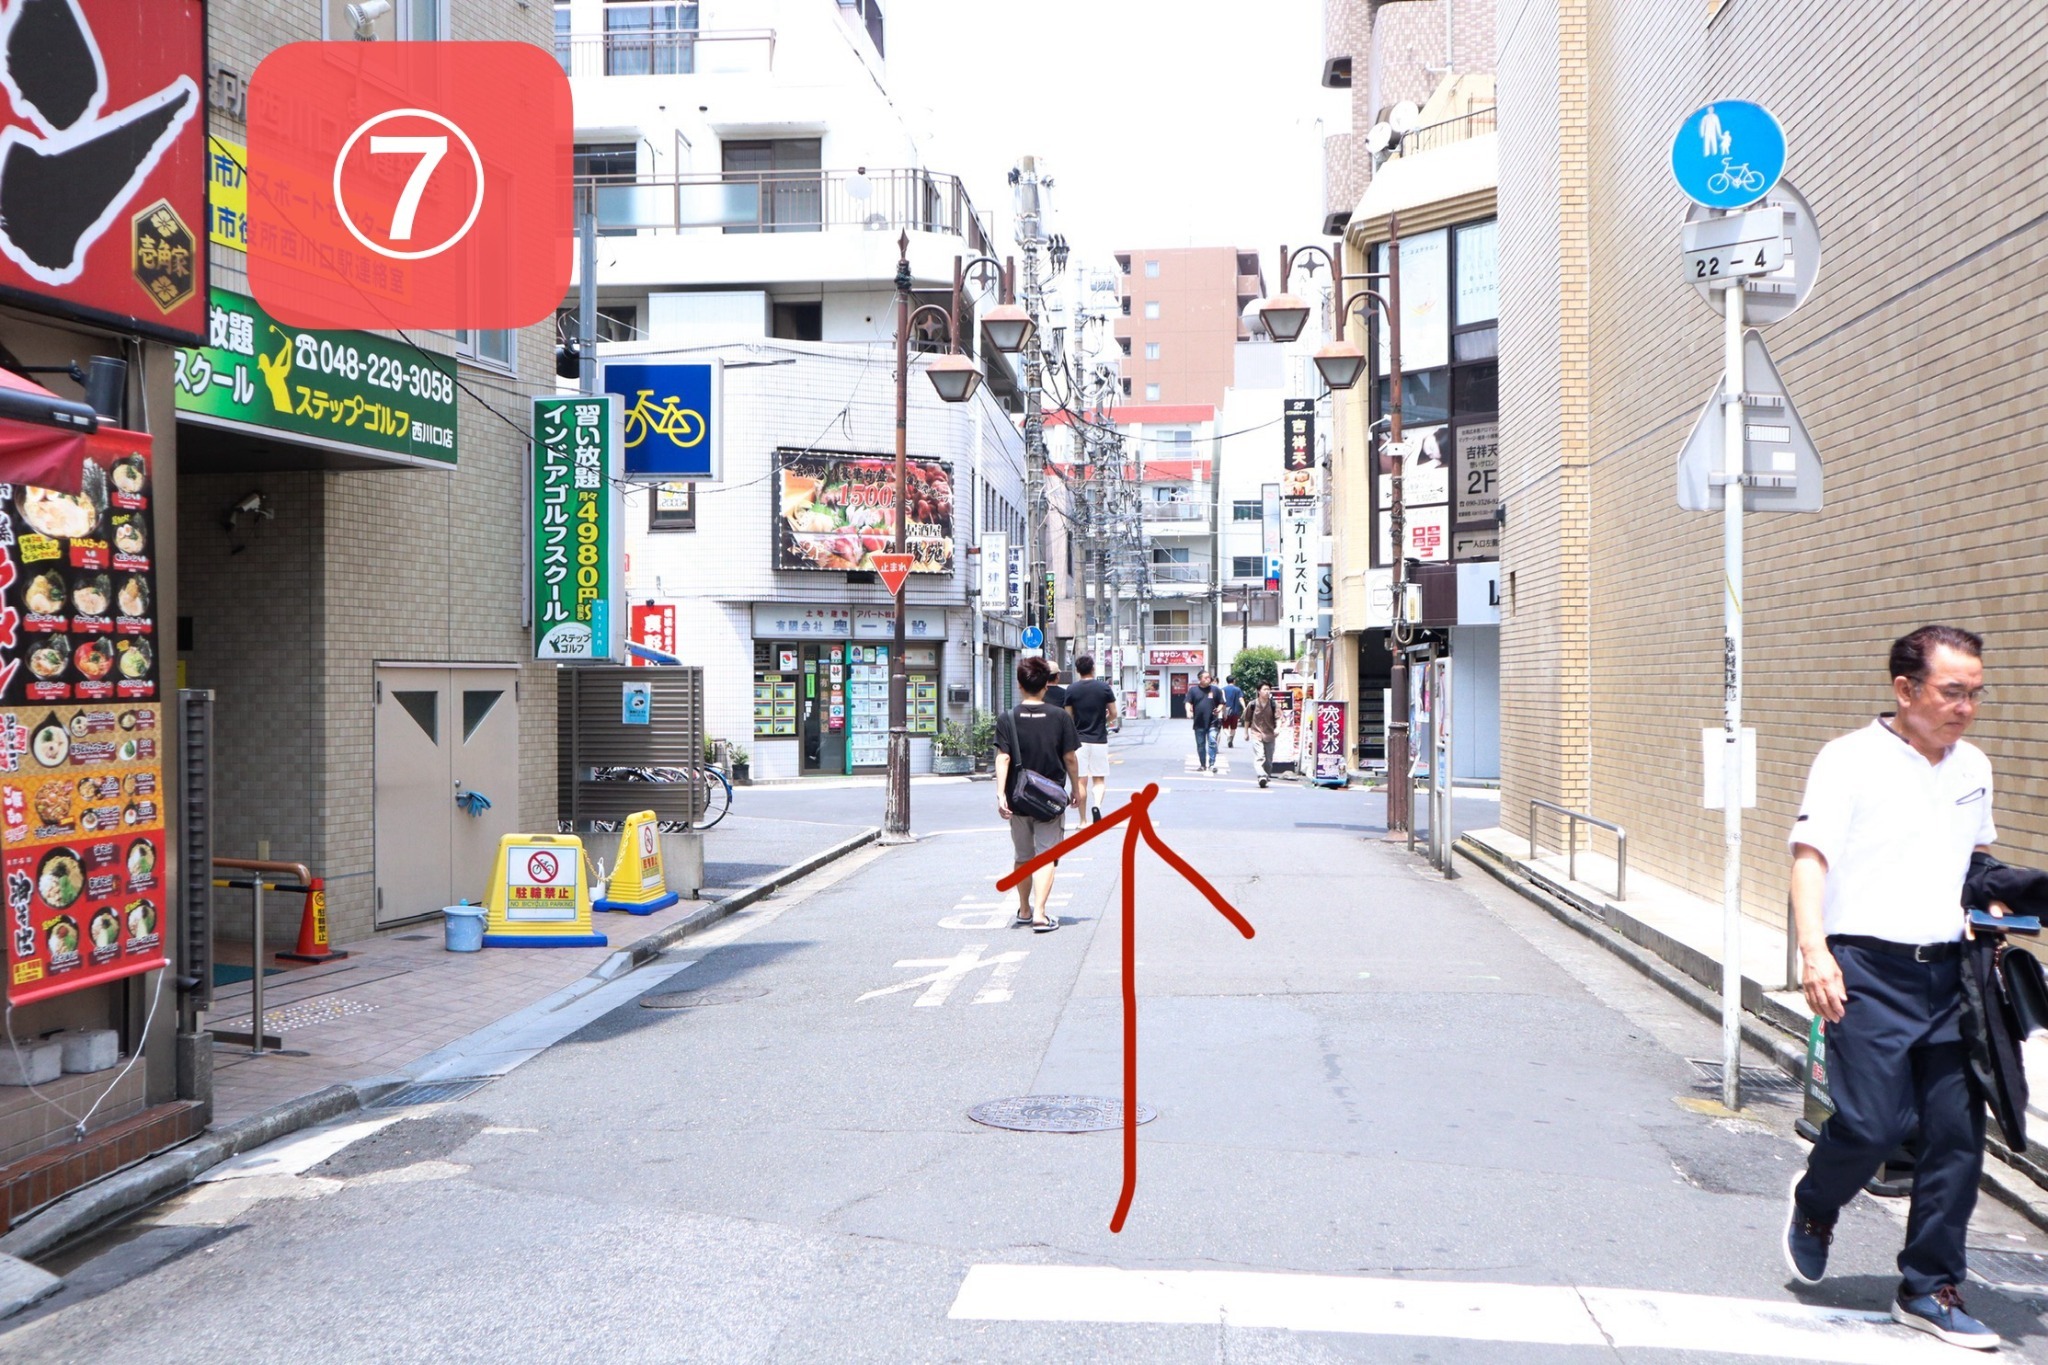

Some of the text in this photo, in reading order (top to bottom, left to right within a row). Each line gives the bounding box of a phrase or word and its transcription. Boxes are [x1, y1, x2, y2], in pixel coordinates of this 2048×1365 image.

[1696, 257, 1720, 279] 22
[1754, 246, 1767, 269] 4
[175, 352, 254, 404] スクール
[320, 340, 453, 404] 048-229-3058
[296, 385, 410, 438] ステップゴルフ
[1293, 401, 1306, 410] 2F
[411, 420, 453, 449] 西川口店
[574, 404, 601, 489] 習い放題
[1291, 418, 1307, 466] 吉祥天
[1466, 443, 1498, 460] 吉祥天
[1467, 469, 1497, 495] 2F
[543, 404, 569, 622] インドアゴルフスクール
[880, 562, 907, 572] 止まれ
[1294, 521, 1308, 610] ガールズバー
[1009, 563, 1019, 608] 奥一建設
[776, 620, 823, 632] 有限会社
[1289, 615, 1303, 623] 1F
[560, 633, 592, 643] ステップ
[561, 645, 584, 653] ゴルフ
[1323, 705, 1340, 754] 六本木
[515, 887, 569, 899] 駐輪禁止
[318, 908, 326, 942] 駐輪禁止
